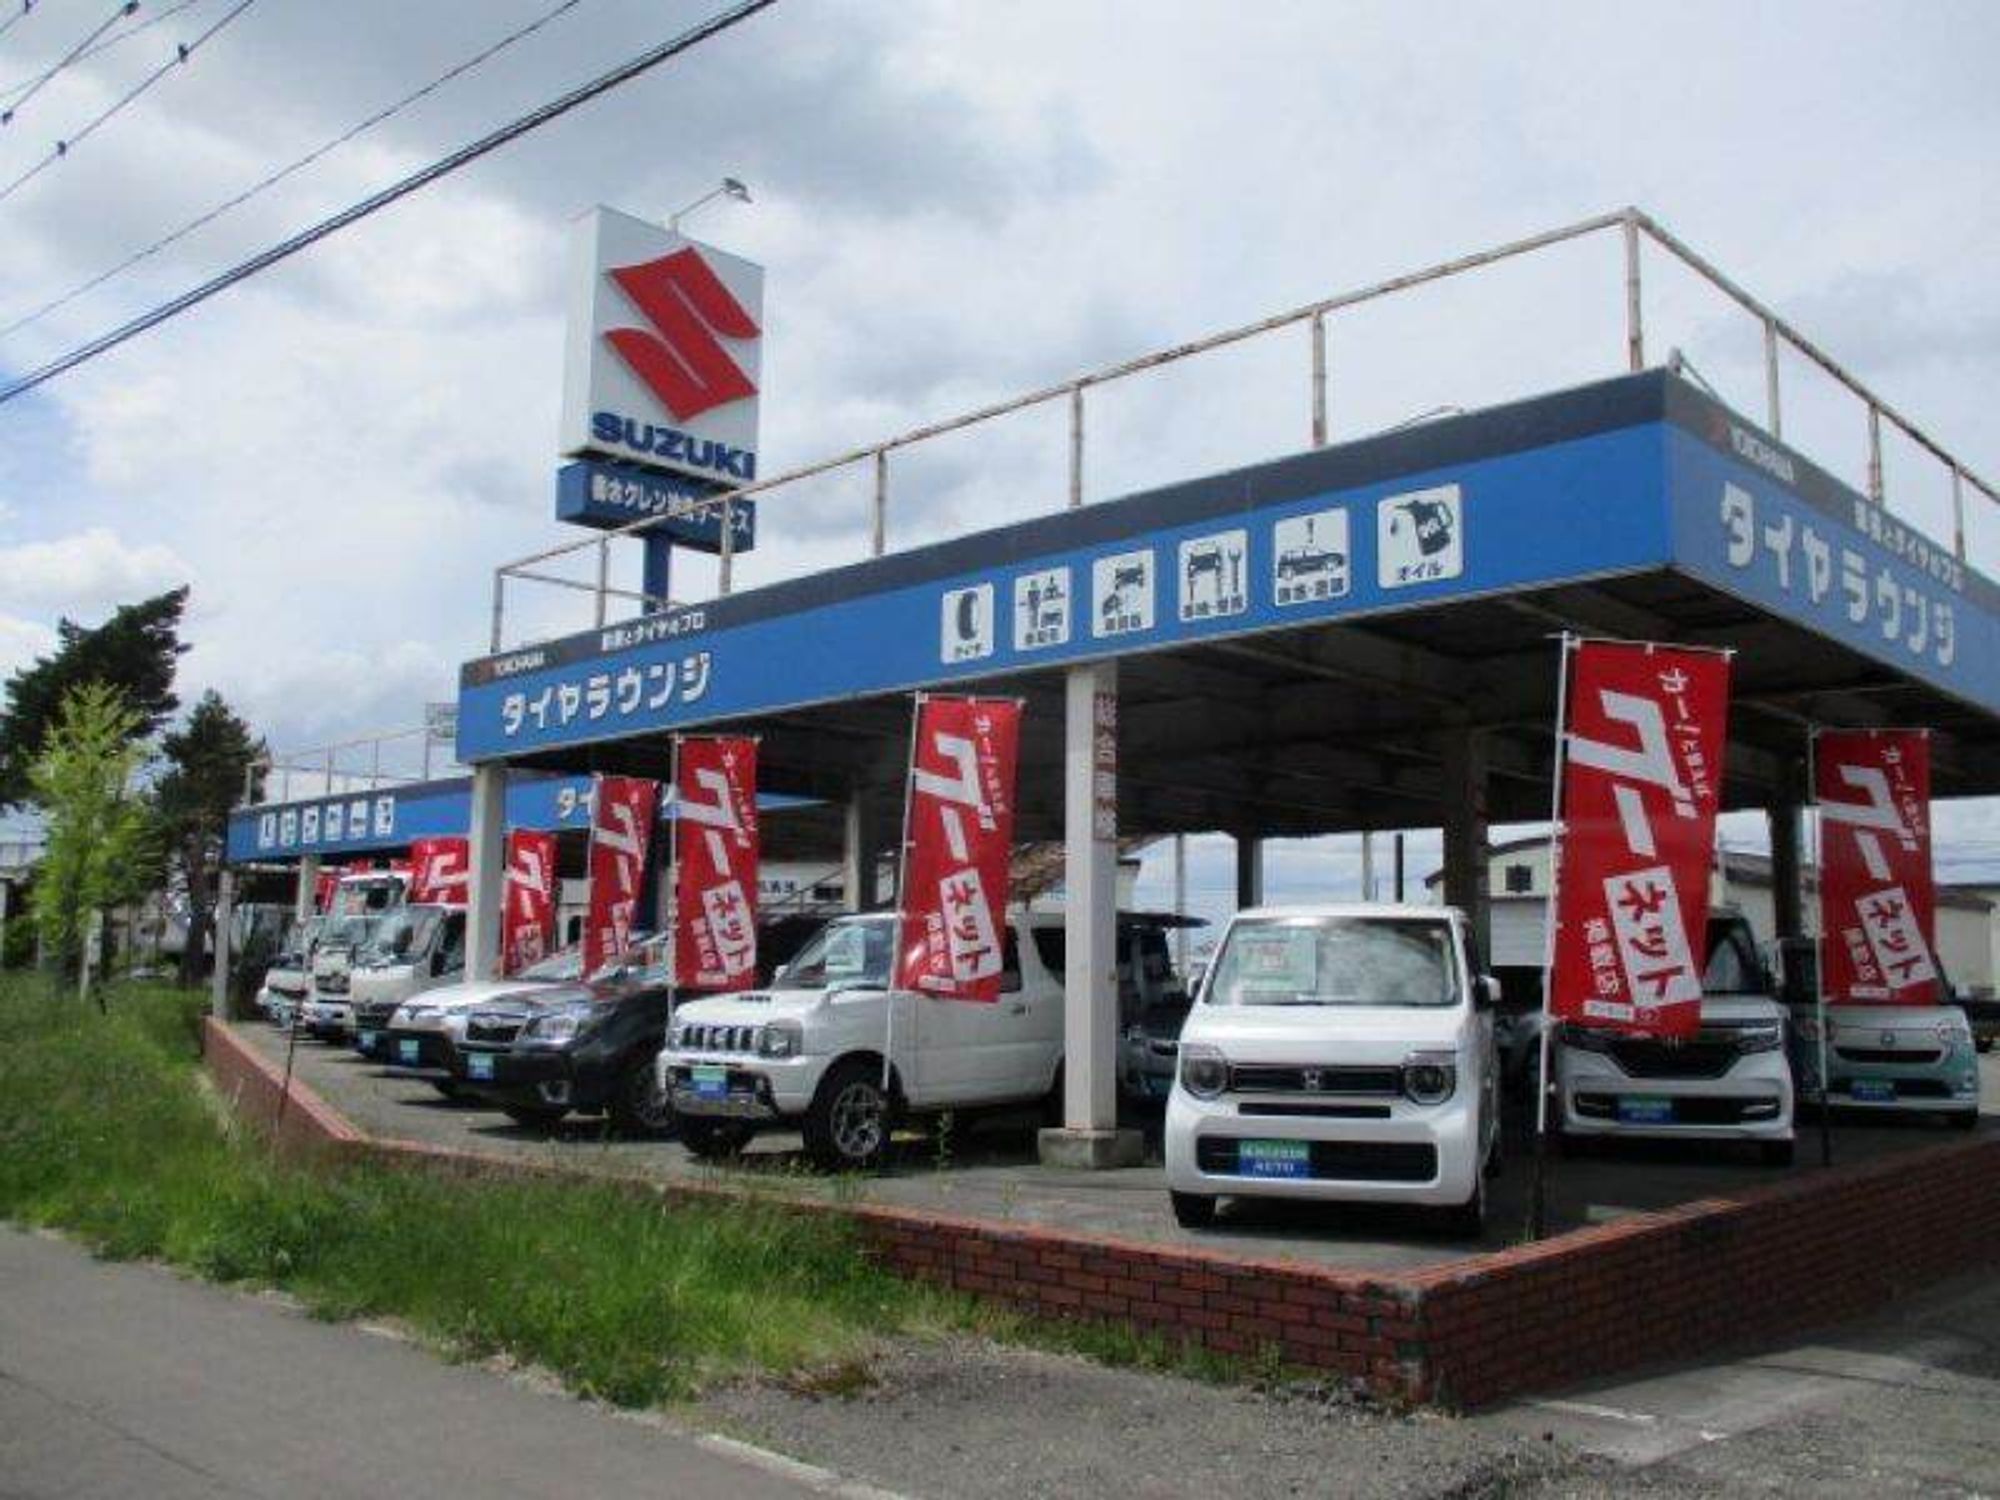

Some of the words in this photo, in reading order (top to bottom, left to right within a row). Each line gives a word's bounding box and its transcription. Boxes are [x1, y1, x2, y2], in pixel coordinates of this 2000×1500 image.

[591, 411, 756, 482] SUZUKI
[1720, 480, 1955, 667] タイヤラウンジ
[502, 652, 711, 736] タイヤラウンジ
